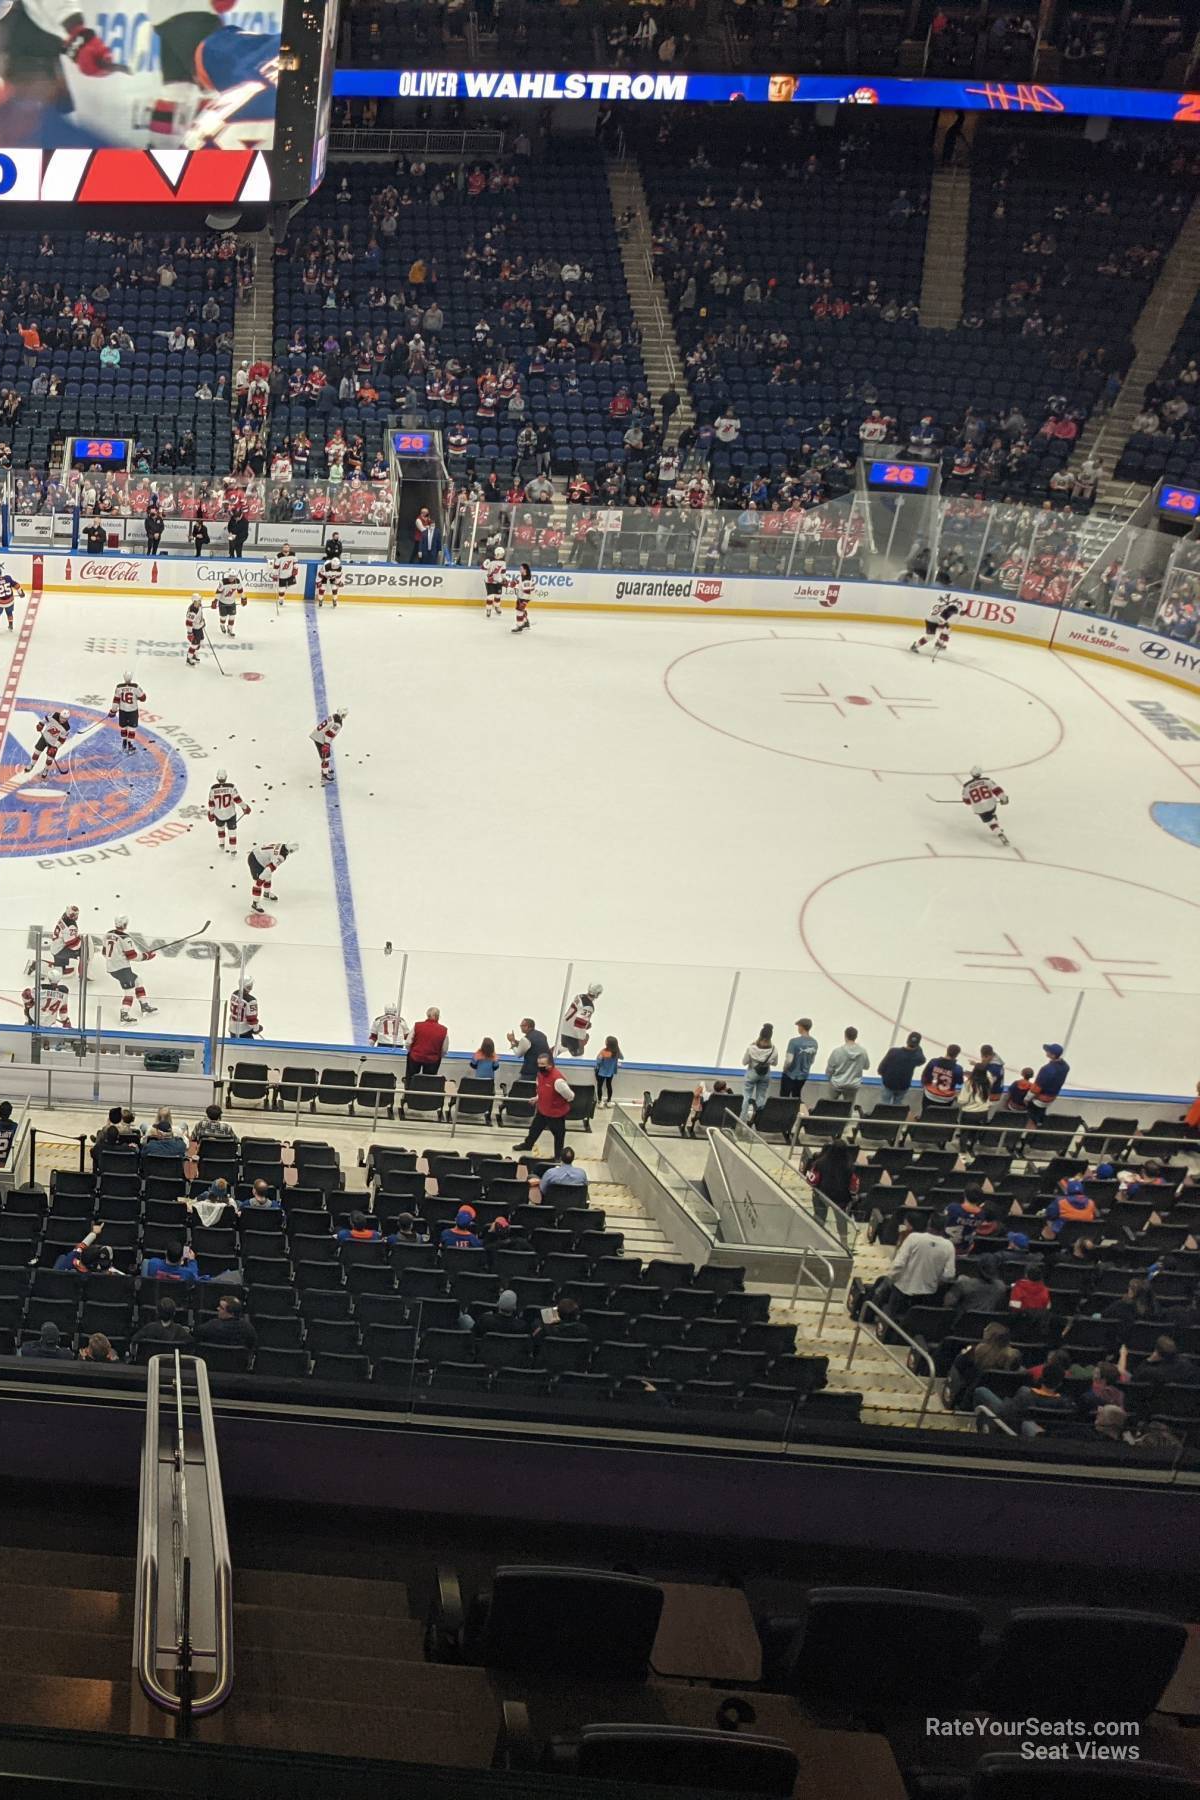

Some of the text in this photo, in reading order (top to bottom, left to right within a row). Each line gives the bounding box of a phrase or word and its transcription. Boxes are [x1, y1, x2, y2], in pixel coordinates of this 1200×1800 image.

[399, 71, 688, 100] OLIVER WAHLSTROM
[87, 442, 113, 457] 26
[399, 436, 424, 449] 26
[883, 466, 914, 482] 26
[1167, 492, 1196, 510] 26
[80, 561, 142, 582] Coca-Cola
[616, 579, 721, 600] guaranteed Rate
[794, 585, 825, 597] Jake's
[964, 599, 1016, 624] UBS
[157, 723, 209, 760] Arena
[213, 794, 232, 809] 70
[969, 786, 992, 803] 86
[135, 821, 191, 848] UBS
[36, 843, 132, 871] Arena
[41, 998, 61, 1014] 14
